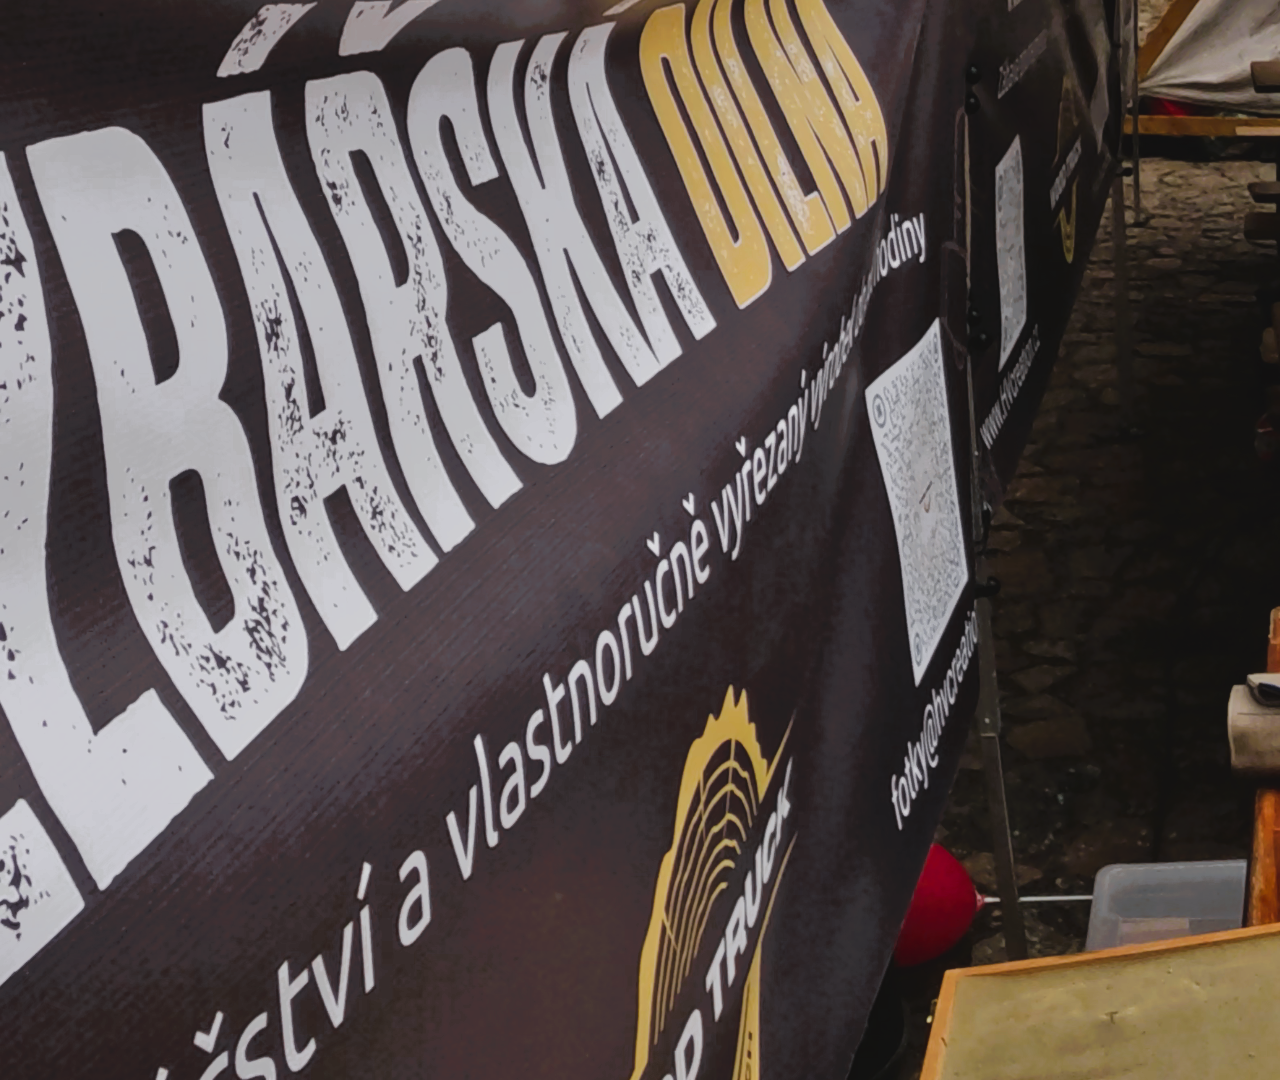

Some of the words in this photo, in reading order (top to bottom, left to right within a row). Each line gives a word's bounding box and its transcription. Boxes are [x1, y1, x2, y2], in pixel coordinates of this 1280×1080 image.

[398, 850, 431, 947] a
[446, 492, 710, 881] vlastnoručně
[711, 369, 809, 561] vyřezaný
[705, 756, 793, 1022] TRUCK
